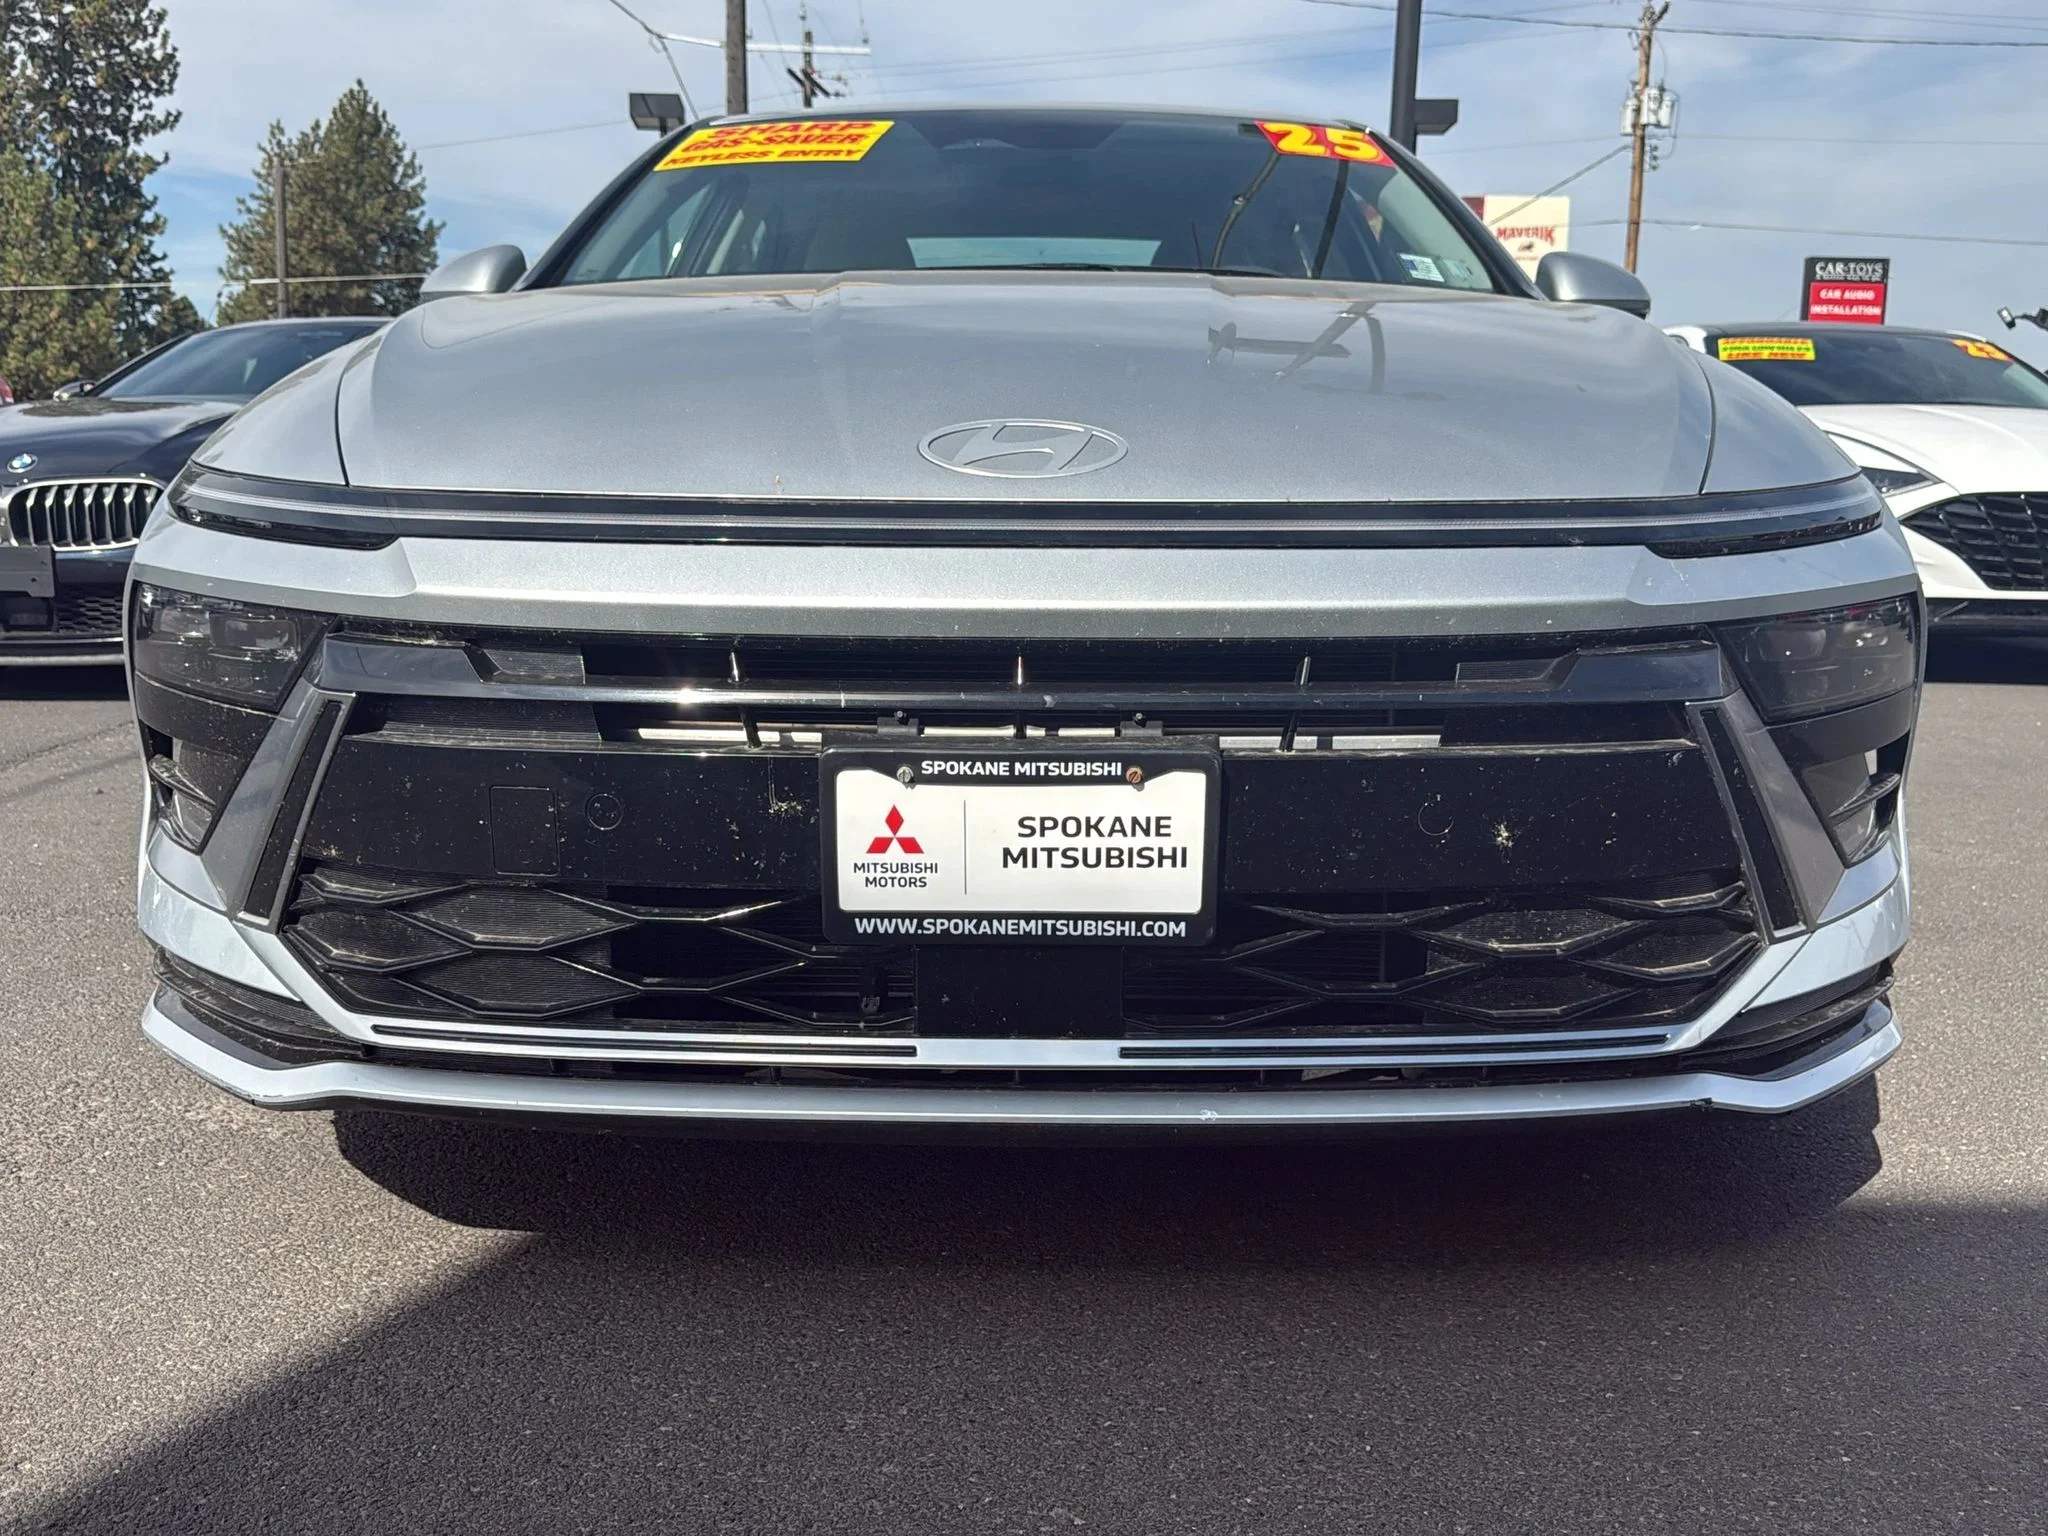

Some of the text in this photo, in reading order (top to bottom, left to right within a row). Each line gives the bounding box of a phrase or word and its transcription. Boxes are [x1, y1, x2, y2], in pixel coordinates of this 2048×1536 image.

[708, 122, 875, 139] SHARP
[1262, 122, 1381, 162] 25
[663, 149, 864, 167] KEYLESS ENTRY
[1496, 226, 1556, 247] MAVERIK
[1819, 288, 1875, 300] CAR AUDIO
[1810, 304, 1881, 316] INSTALLATION
[921, 760, 1122, 777] SPOKANE MITSUBISHI
[1017, 815, 1172, 838] SPOKANE
[1002, 846, 1187, 869] MITSUBISHI
[853, 862, 938, 875] MITSUBISHI
[865, 876, 927, 888] MOTORS
[854, 917, 1186, 938] WWW.SPOKANEMITSUBISHI.COM
